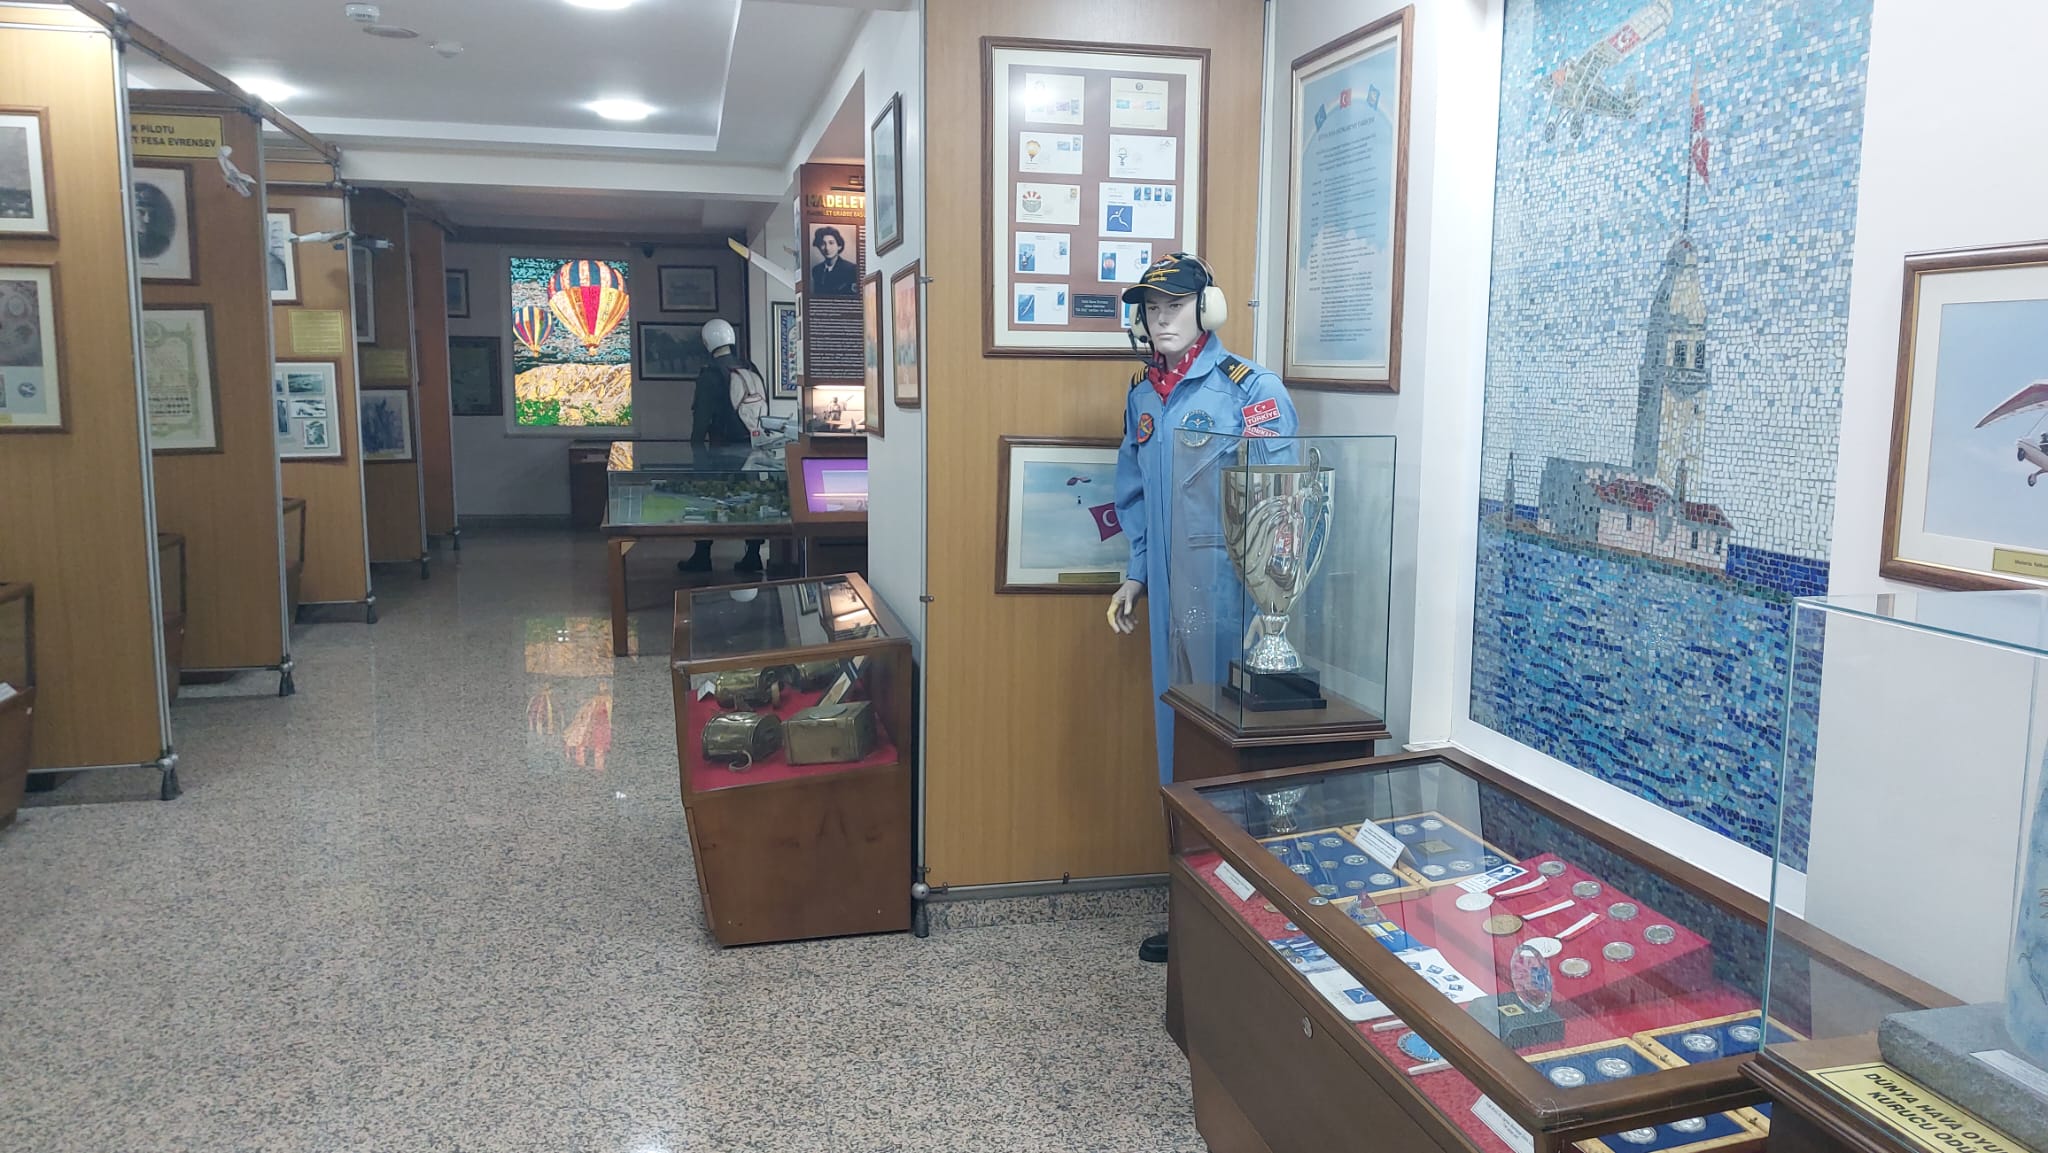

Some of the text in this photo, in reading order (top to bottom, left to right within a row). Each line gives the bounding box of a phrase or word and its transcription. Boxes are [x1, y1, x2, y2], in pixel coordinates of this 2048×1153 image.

[141, 136, 165, 145] FESA
[168, 138, 216, 147] EVRENSEV
[1247, 410, 1278, 425] TÜRKİYE
[1863, 1073, 1919, 1105] DÜNYA
[1916, 1104, 1963, 1131] HAVA
[1867, 1091, 1939, 1131] KURUCU
